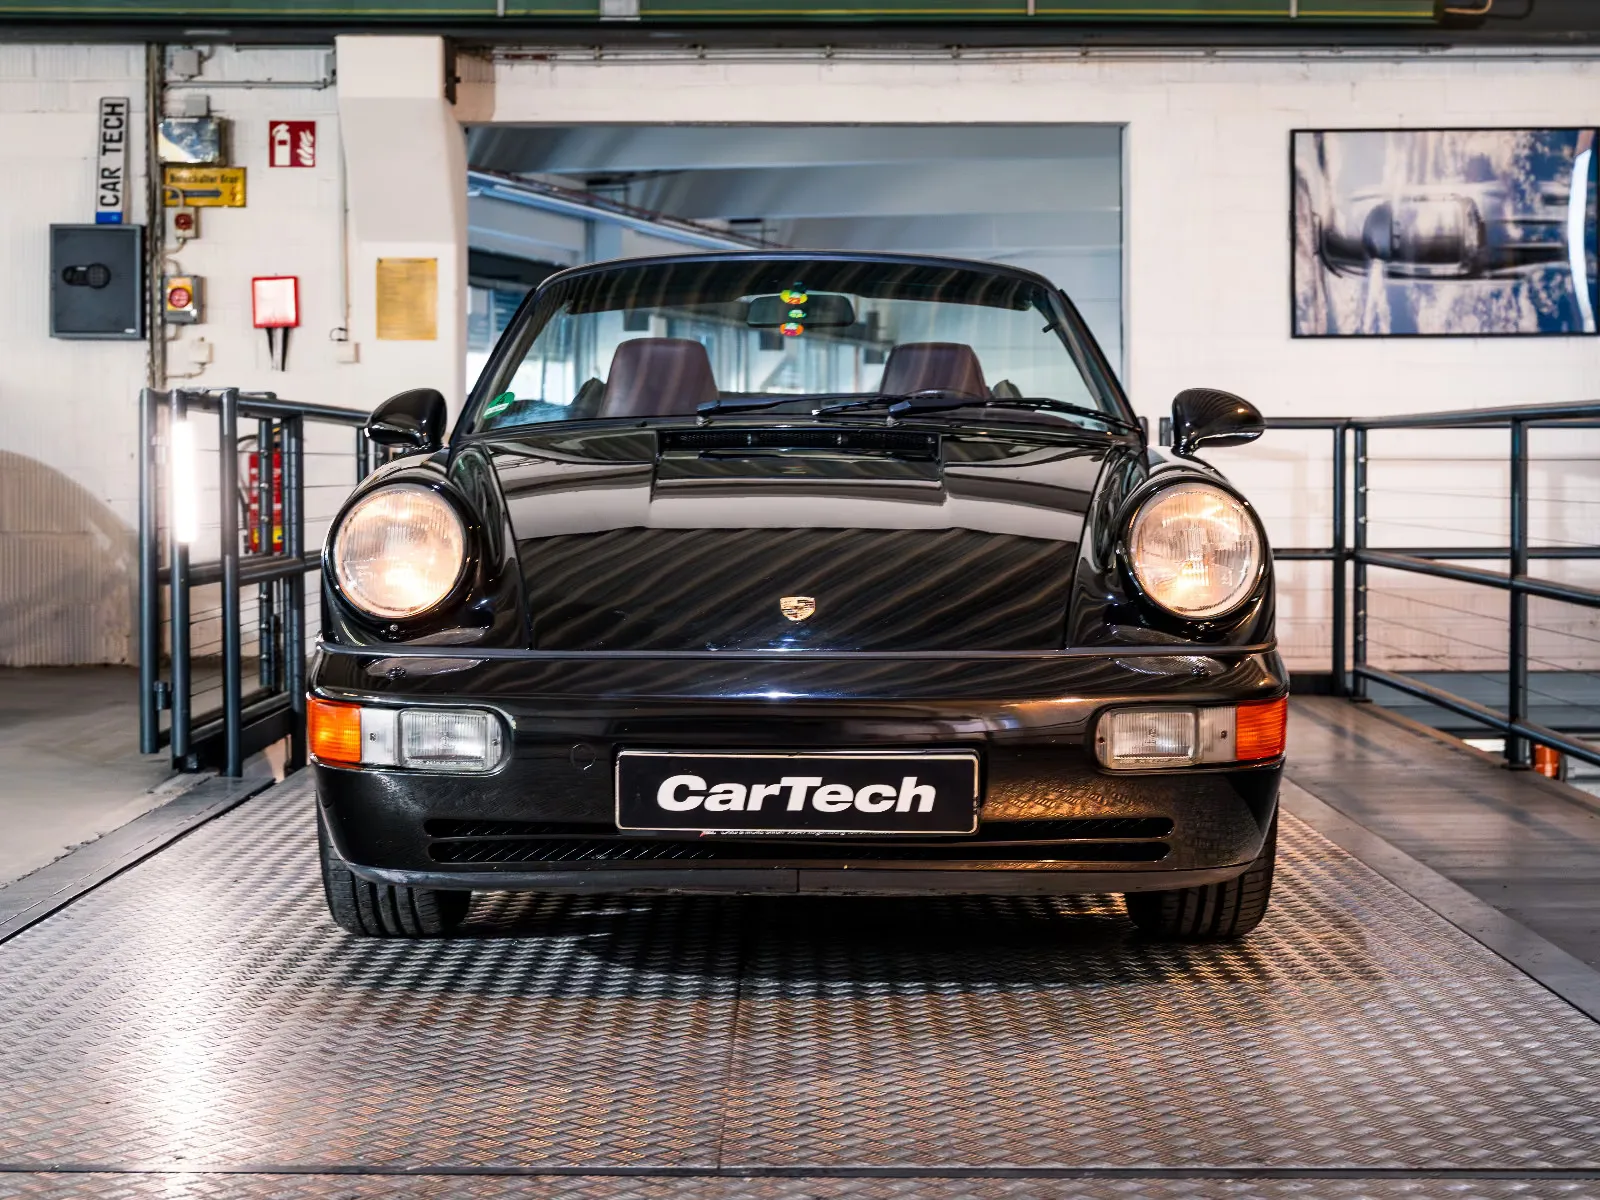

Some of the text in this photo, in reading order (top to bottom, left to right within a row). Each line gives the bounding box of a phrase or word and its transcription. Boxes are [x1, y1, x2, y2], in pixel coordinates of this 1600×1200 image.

[100, 103, 125, 207] CAR TECH
[656, 774, 937, 813] CarTech
